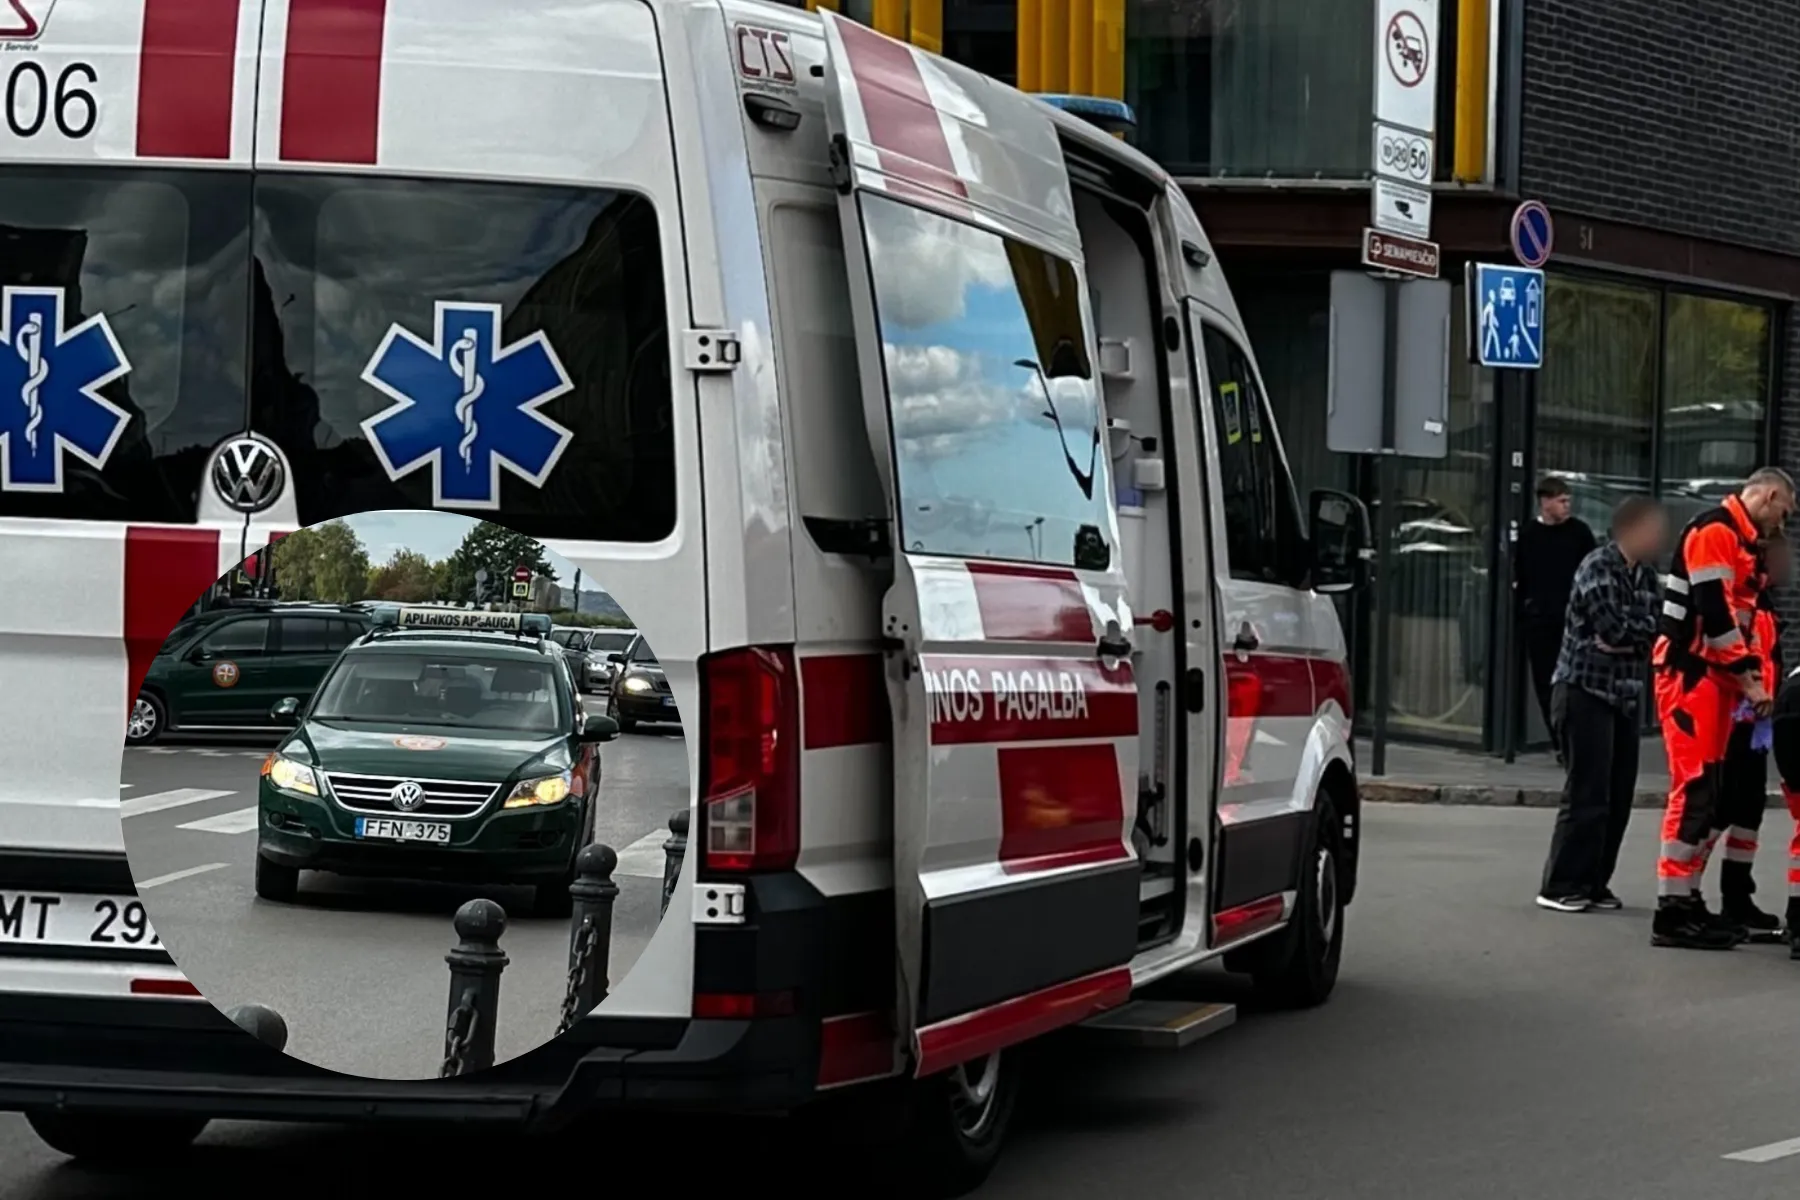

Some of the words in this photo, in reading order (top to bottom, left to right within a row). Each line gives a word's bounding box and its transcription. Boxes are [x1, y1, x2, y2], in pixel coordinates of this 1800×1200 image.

[1411, 148, 1427, 170] 50
[991, 671, 1089, 721] PAGALBA
[365, 820, 403, 837] FFN
[415, 823, 448, 841] 375
[91, 899, 159, 945] 29
